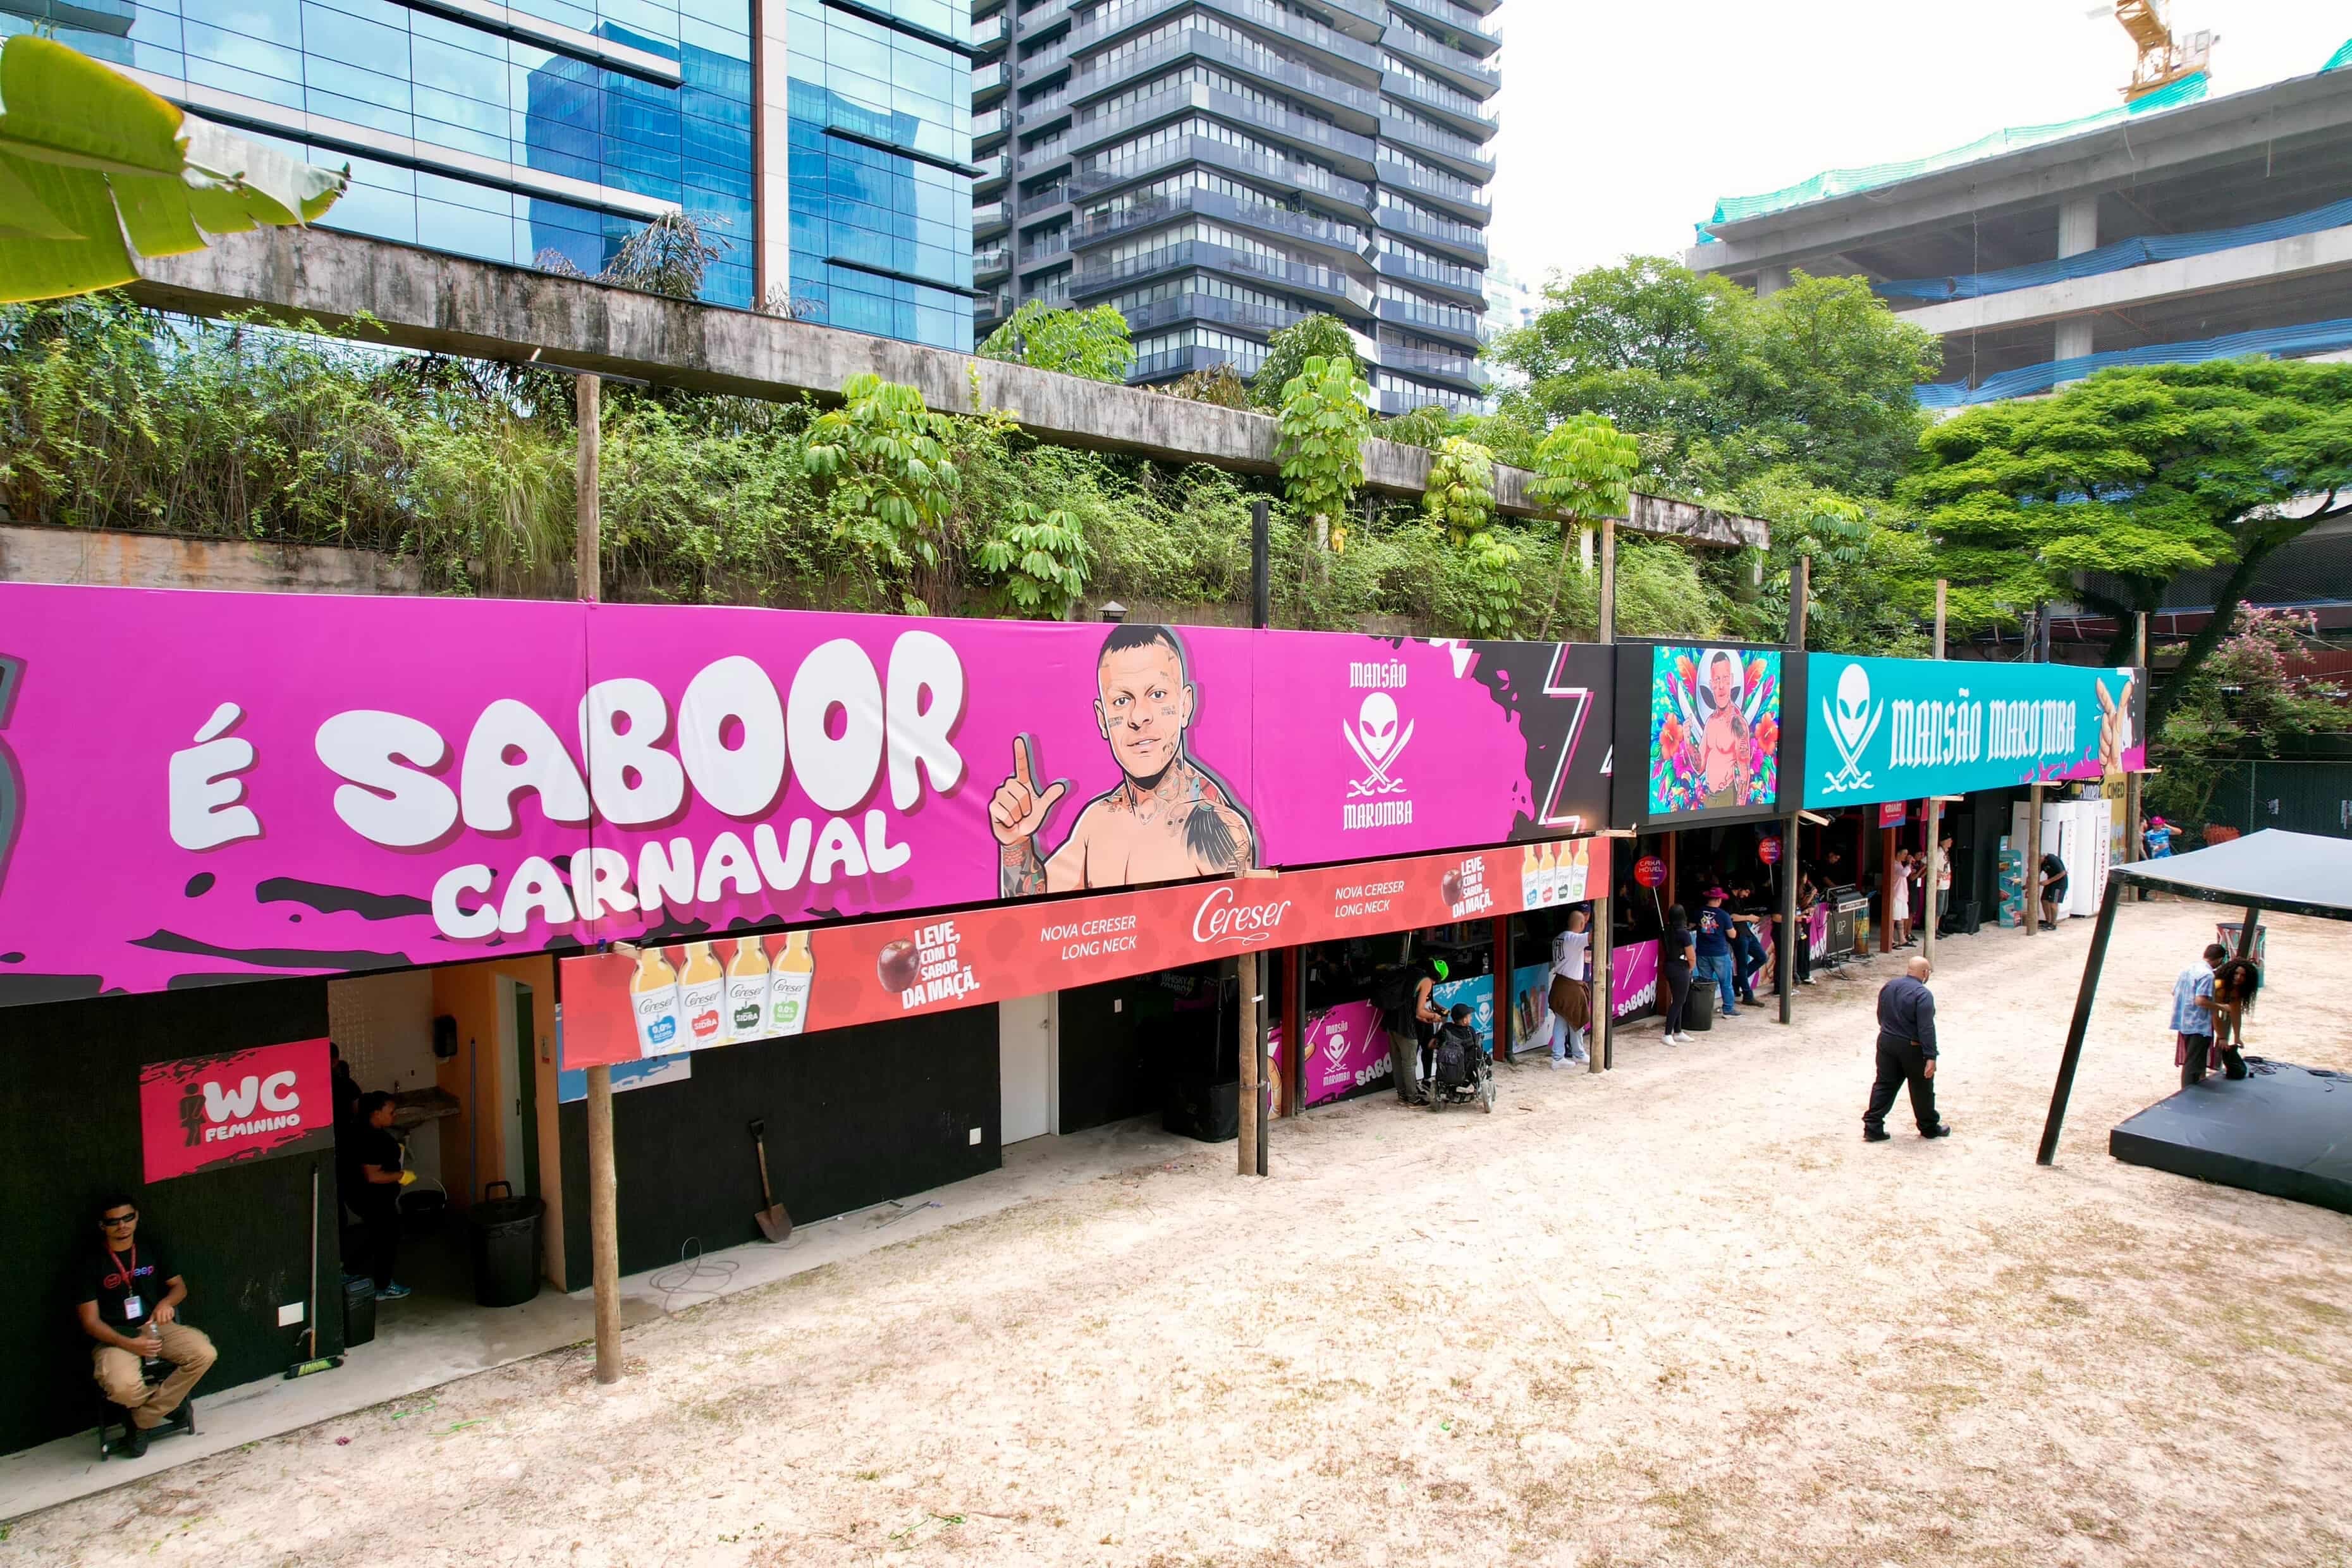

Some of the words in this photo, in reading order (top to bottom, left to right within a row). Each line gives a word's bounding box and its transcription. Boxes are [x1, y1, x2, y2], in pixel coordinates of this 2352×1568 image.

[1349, 658, 1407, 688] MANSÃO
[169, 702, 260, 850] É
[315, 630, 964, 847] SABOOR
[1888, 687, 1981, 770] MANSÃO
[1986, 699, 2076, 763] MAROMBA
[1343, 800, 1413, 831] MAROMBA
[432, 809, 910, 940] CARNAVAL
[1461, 856, 1485, 876] LEVE,
[1335, 888, 1363, 900] NOVA
[1364, 881, 1404, 897] CERESER
[1463, 884, 1482, 898] SABOR
[1464, 874, 1476, 887] COM
[1478, 872, 1482, 882] O
[1335, 903, 1363, 917] LONG
[1364, 900, 1390, 912] NECK
[1452, 903, 1466, 918] DA
[1466, 888, 1493, 913] MAÇÃ.
[1193, 887, 1291, 945] Cereser
[914, 921, 961, 950] LEVE,
[1041, 923, 1079, 942] NOVA
[1081, 915, 1137, 937] CERESER
[921, 945, 945, 965] COM
[948, 943, 957, 958] O
[1062, 941, 1099, 960] LONG
[1102, 936, 1137, 953] NECK
[921, 959, 959, 981] SABOR
[684, 991, 720, 1007] Cereser
[730, 984, 764, 1004] Cereser
[902, 984, 926, 1010] DA
[927, 965, 981, 1002] MAÇÃ.
[639, 996, 675, 1015] Cereser
[736, 1013, 759, 1022] SIDRA
[693, 1019, 718, 1031] SIDRA
[203, 1071, 300, 1122] WC
[205, 1113, 300, 1142] FEMININO
